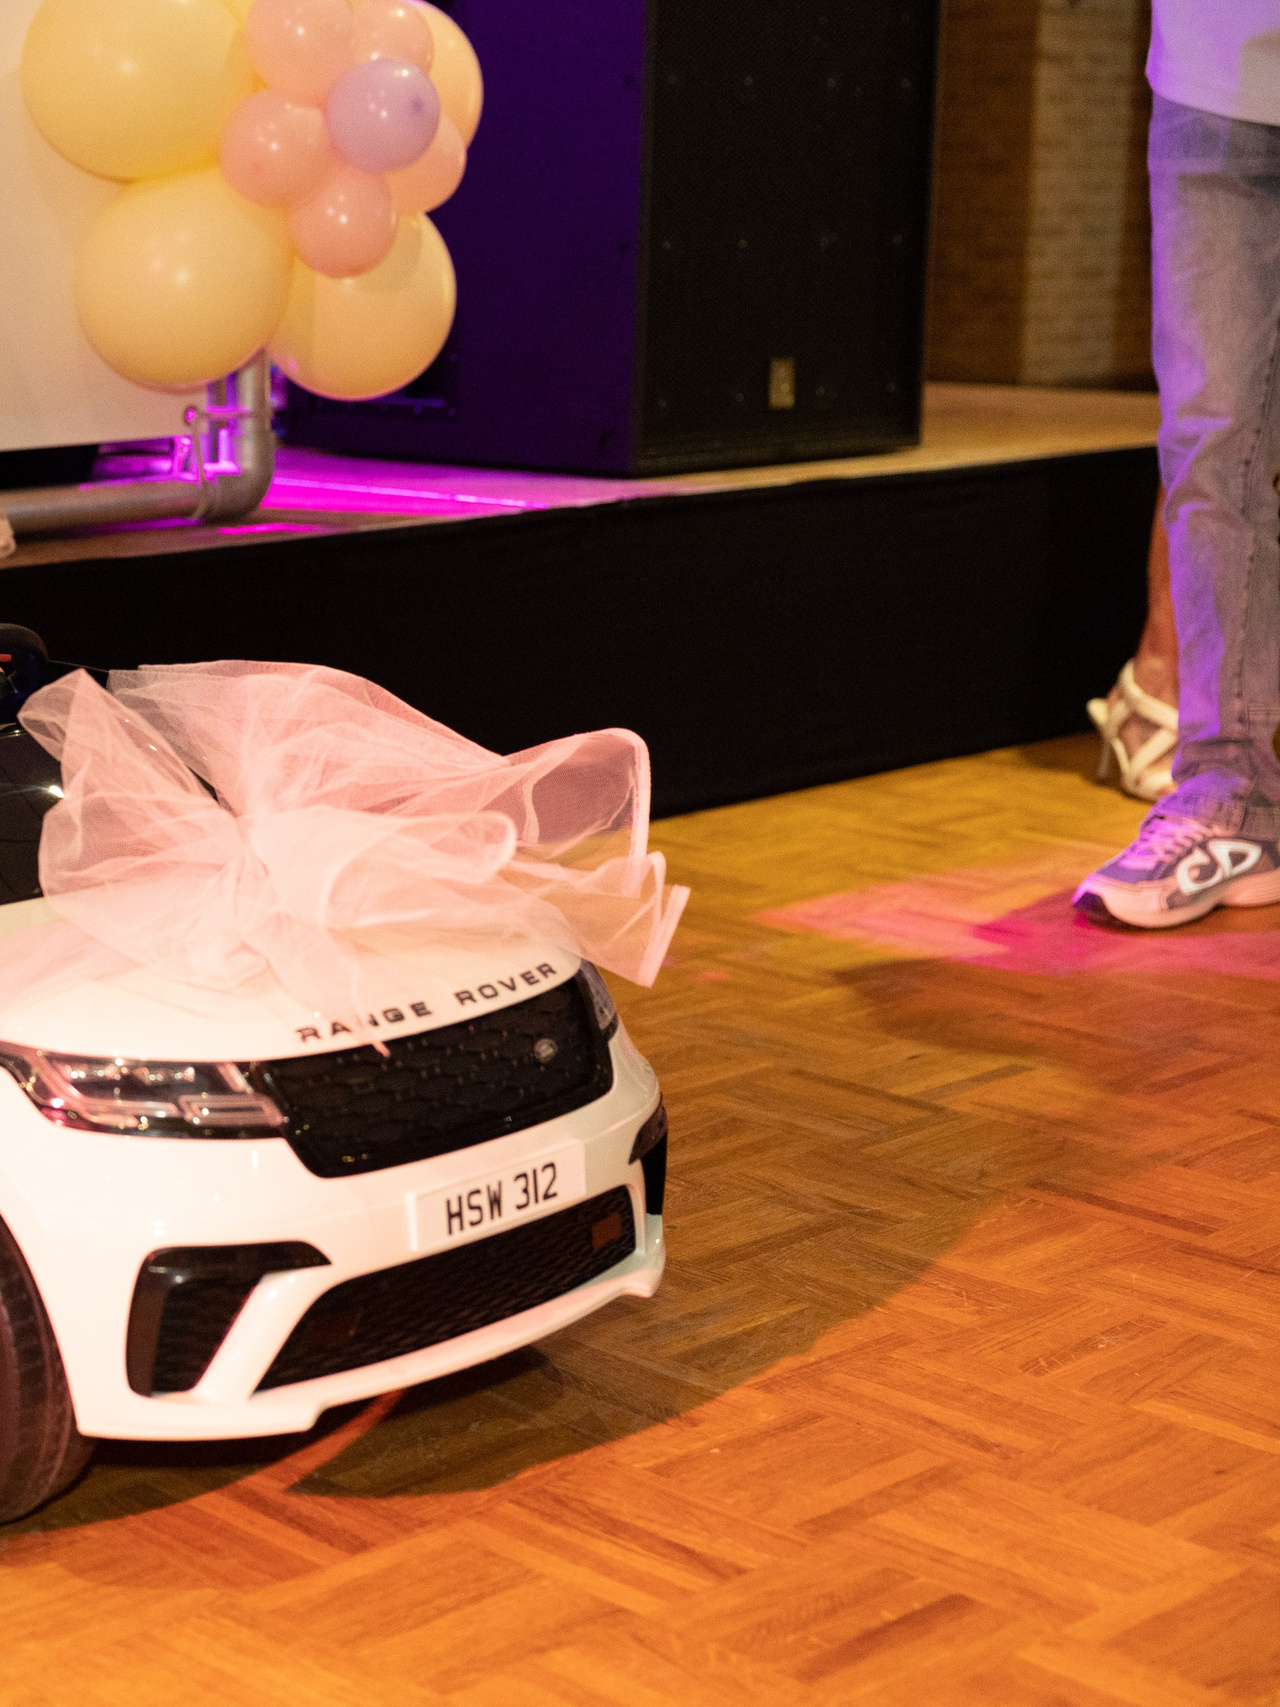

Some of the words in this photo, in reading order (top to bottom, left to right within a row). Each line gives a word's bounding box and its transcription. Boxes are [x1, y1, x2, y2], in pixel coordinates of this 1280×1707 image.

[454, 963, 557, 1006] ROVER
[446, 1180, 502, 1235] HSW
[514, 1162, 558, 1210] 312
